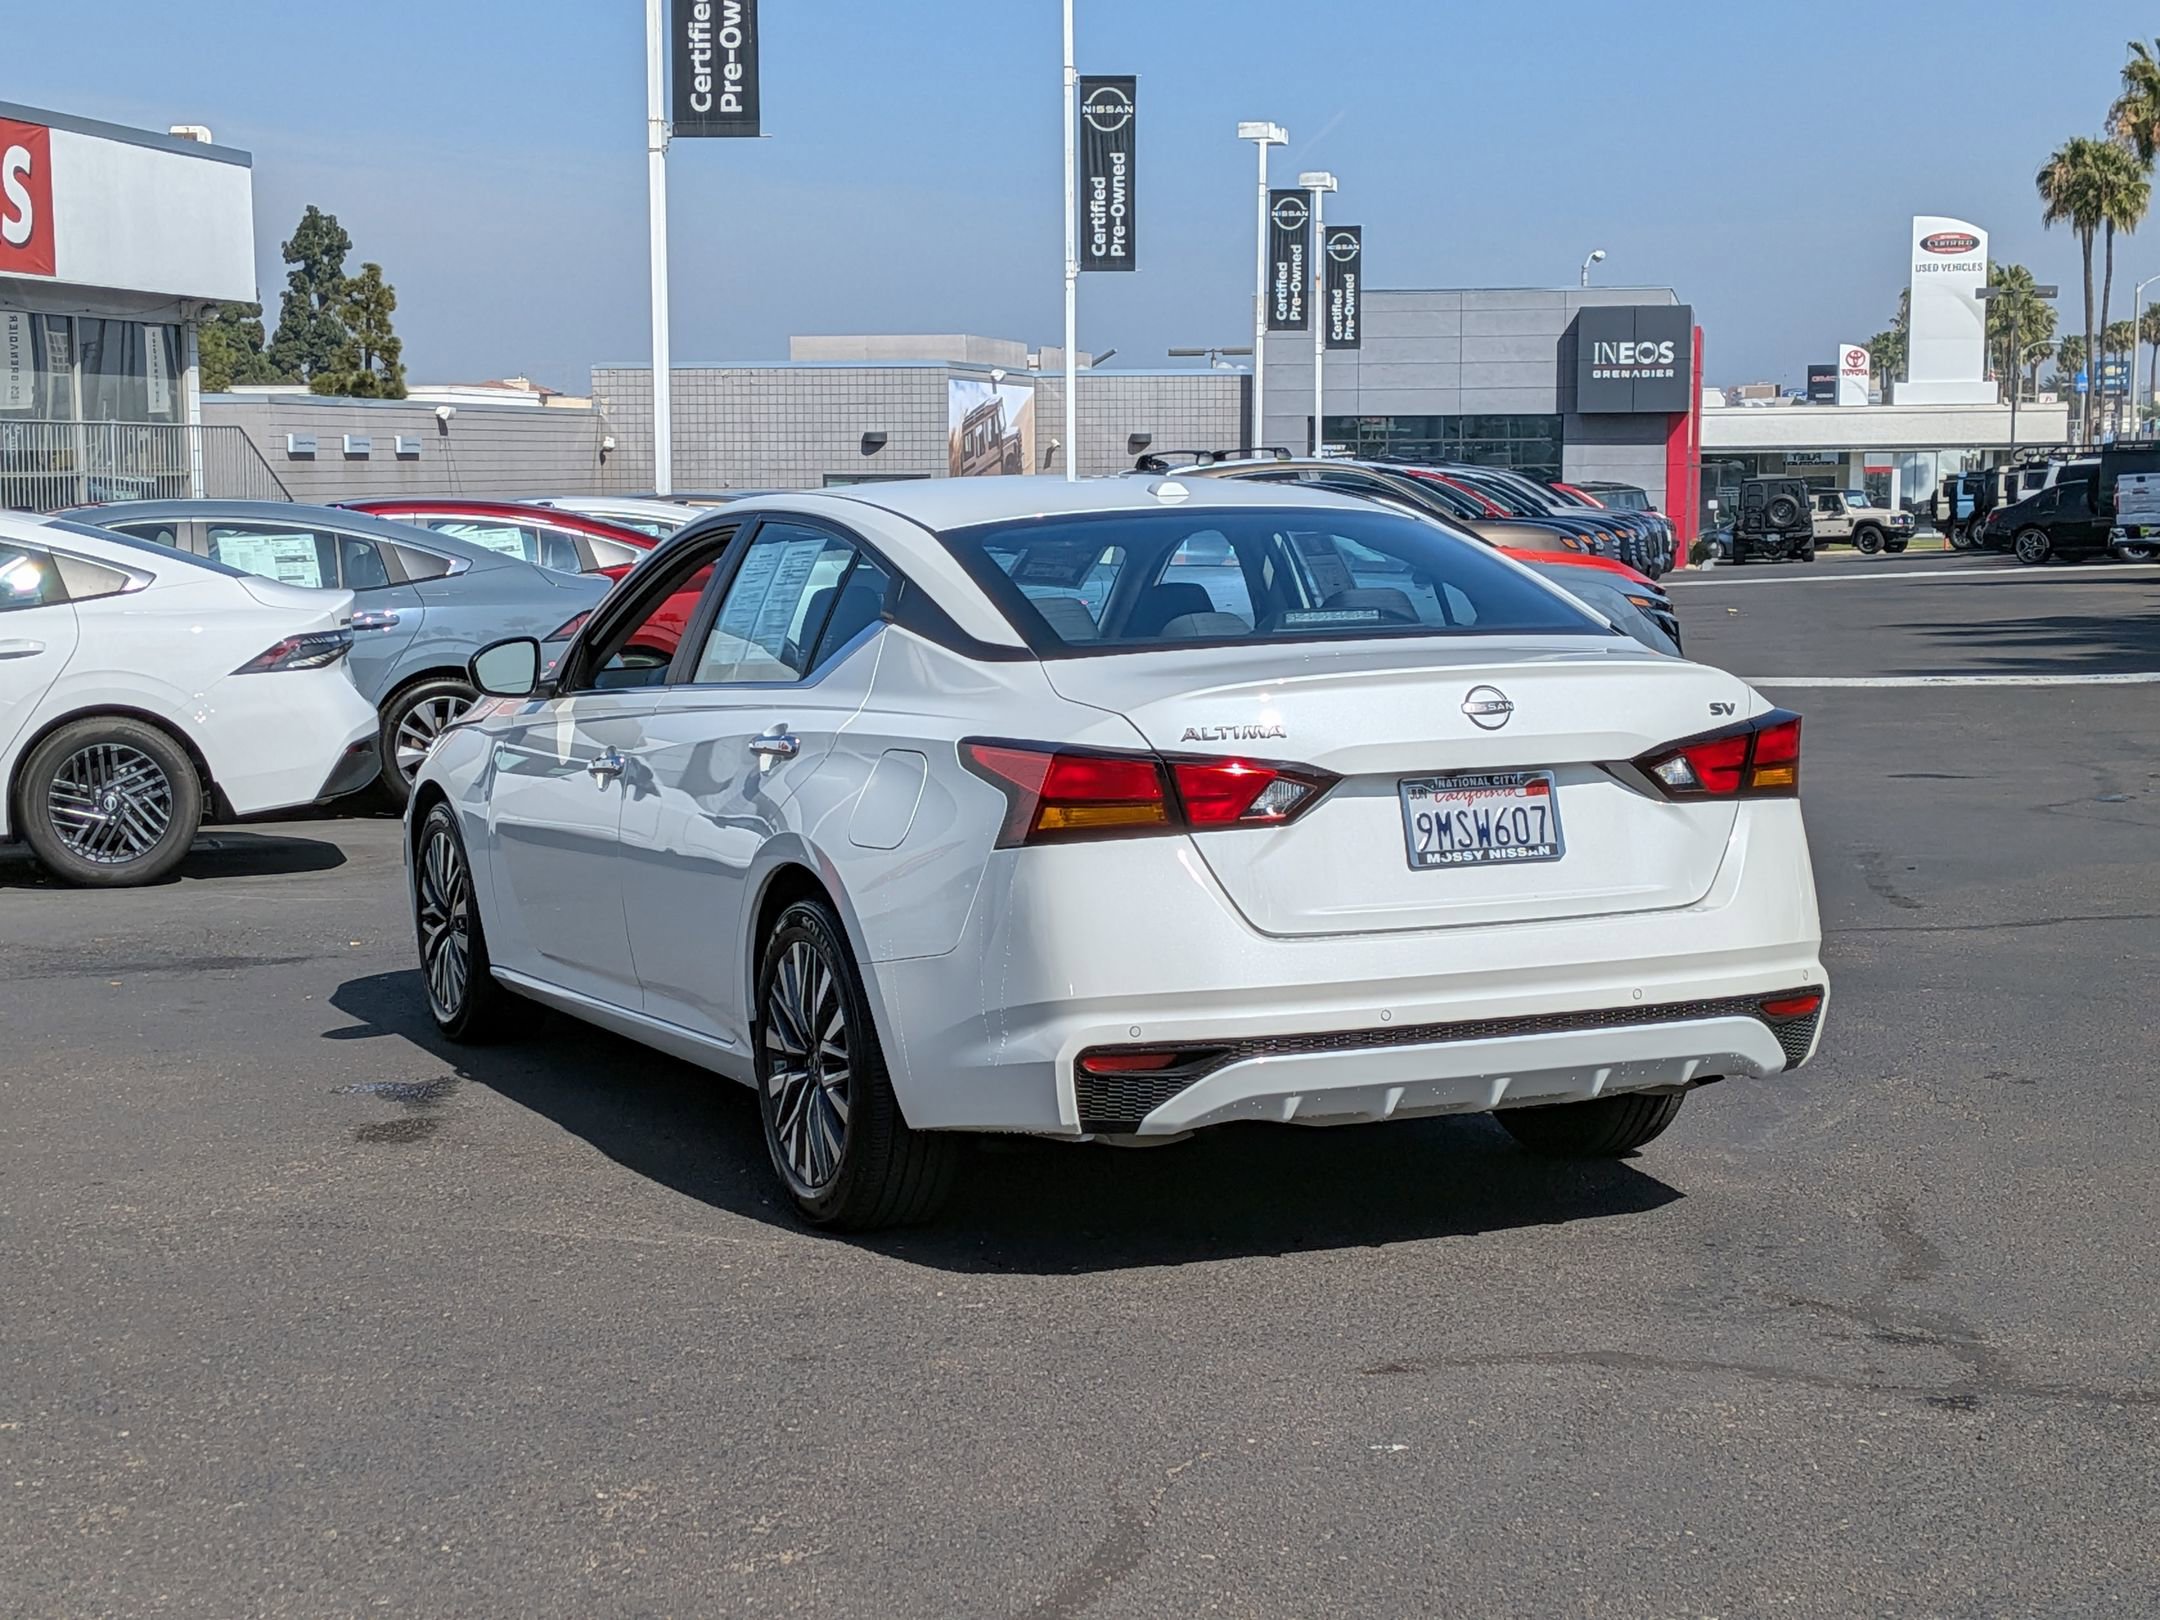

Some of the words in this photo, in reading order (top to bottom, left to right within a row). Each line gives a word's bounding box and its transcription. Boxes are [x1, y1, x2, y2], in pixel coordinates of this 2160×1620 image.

[688, 0, 712, 113] Certifie
[1082, 105, 1134, 114] NISSAN
[1090, 176, 1106, 257] Certified
[1109, 152, 1126, 257] Pre-Owned
[1915, 263, 1939, 272] USED
[1941, 263, 1983, 272] VEHICLES
[1276, 262, 1288, 321] Certified
[1289, 244, 1303, 321] Pre-Owned
[1332, 289, 1343, 341] Certified
[1344, 273, 1355, 341] Pre-Owned
[1593, 341, 1675, 365] INEOS
[1592, 369, 1675, 379] GRENADIER
[1709, 702, 1735, 716] SV
[1181, 725, 1287, 742] ALTIMA
[1438, 777, 1491, 789] NATIONAL
[1492, 775, 1516, 786] CITY
[1435, 788, 1517, 807] California
[1416, 805, 1546, 852] 9MSW607
[1426, 851, 1484, 864] MOSSY
[1489, 845, 1552, 860] NISSAN
